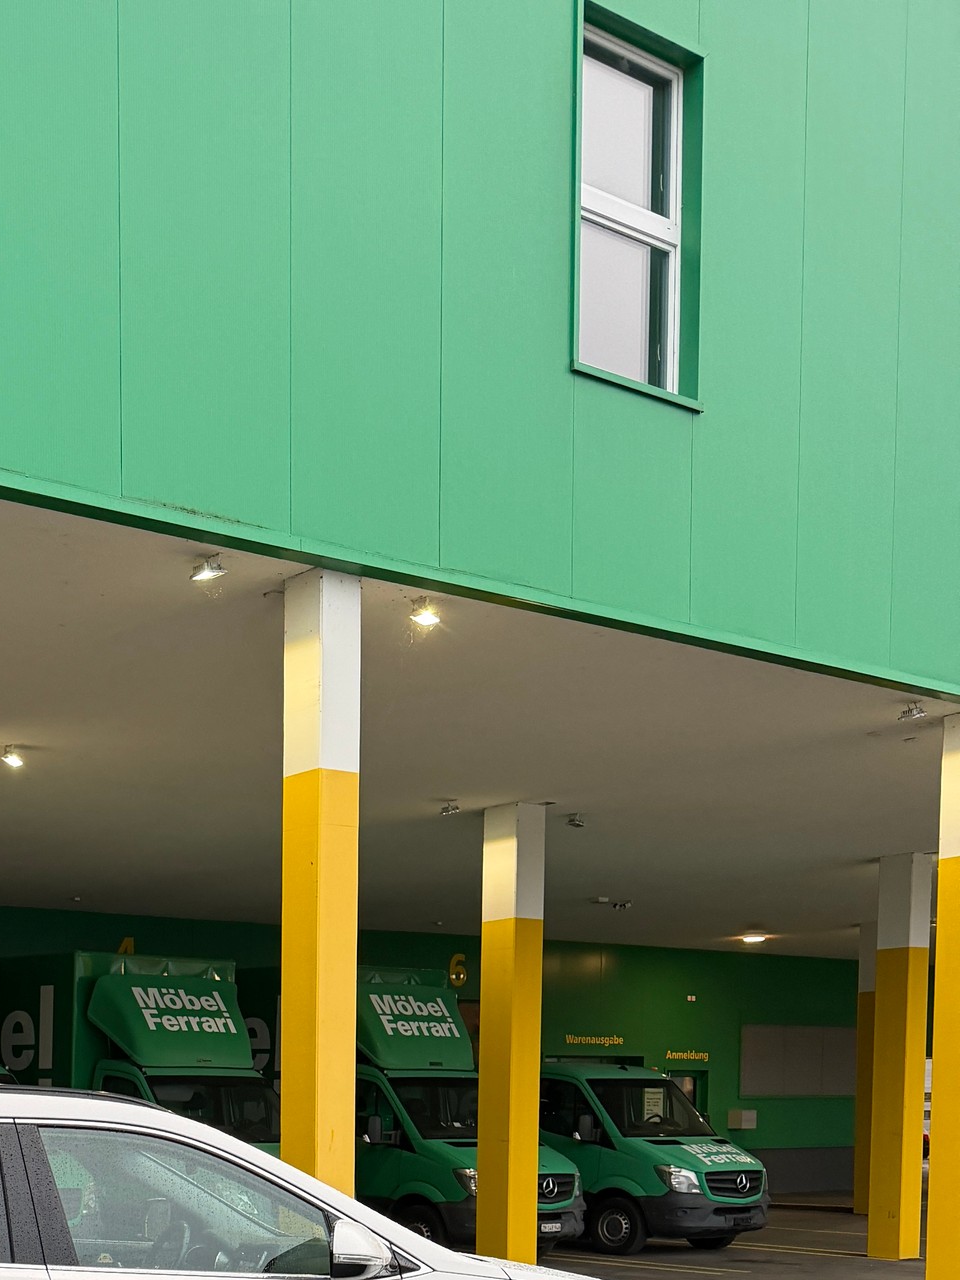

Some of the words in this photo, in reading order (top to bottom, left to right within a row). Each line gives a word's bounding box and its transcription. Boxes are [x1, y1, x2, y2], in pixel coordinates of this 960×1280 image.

[449, 953, 467, 987] 6
[131, 987, 228, 1012] Möbel
[369, 994, 450, 1017] Möbel
[141, 1009, 238, 1034] Ferrari
[379, 1015, 461, 1037] Ferrari
[565, 1034, 624, 1047] Warenausgabe
[665, 1050, 709, 1062] Anmeldung
